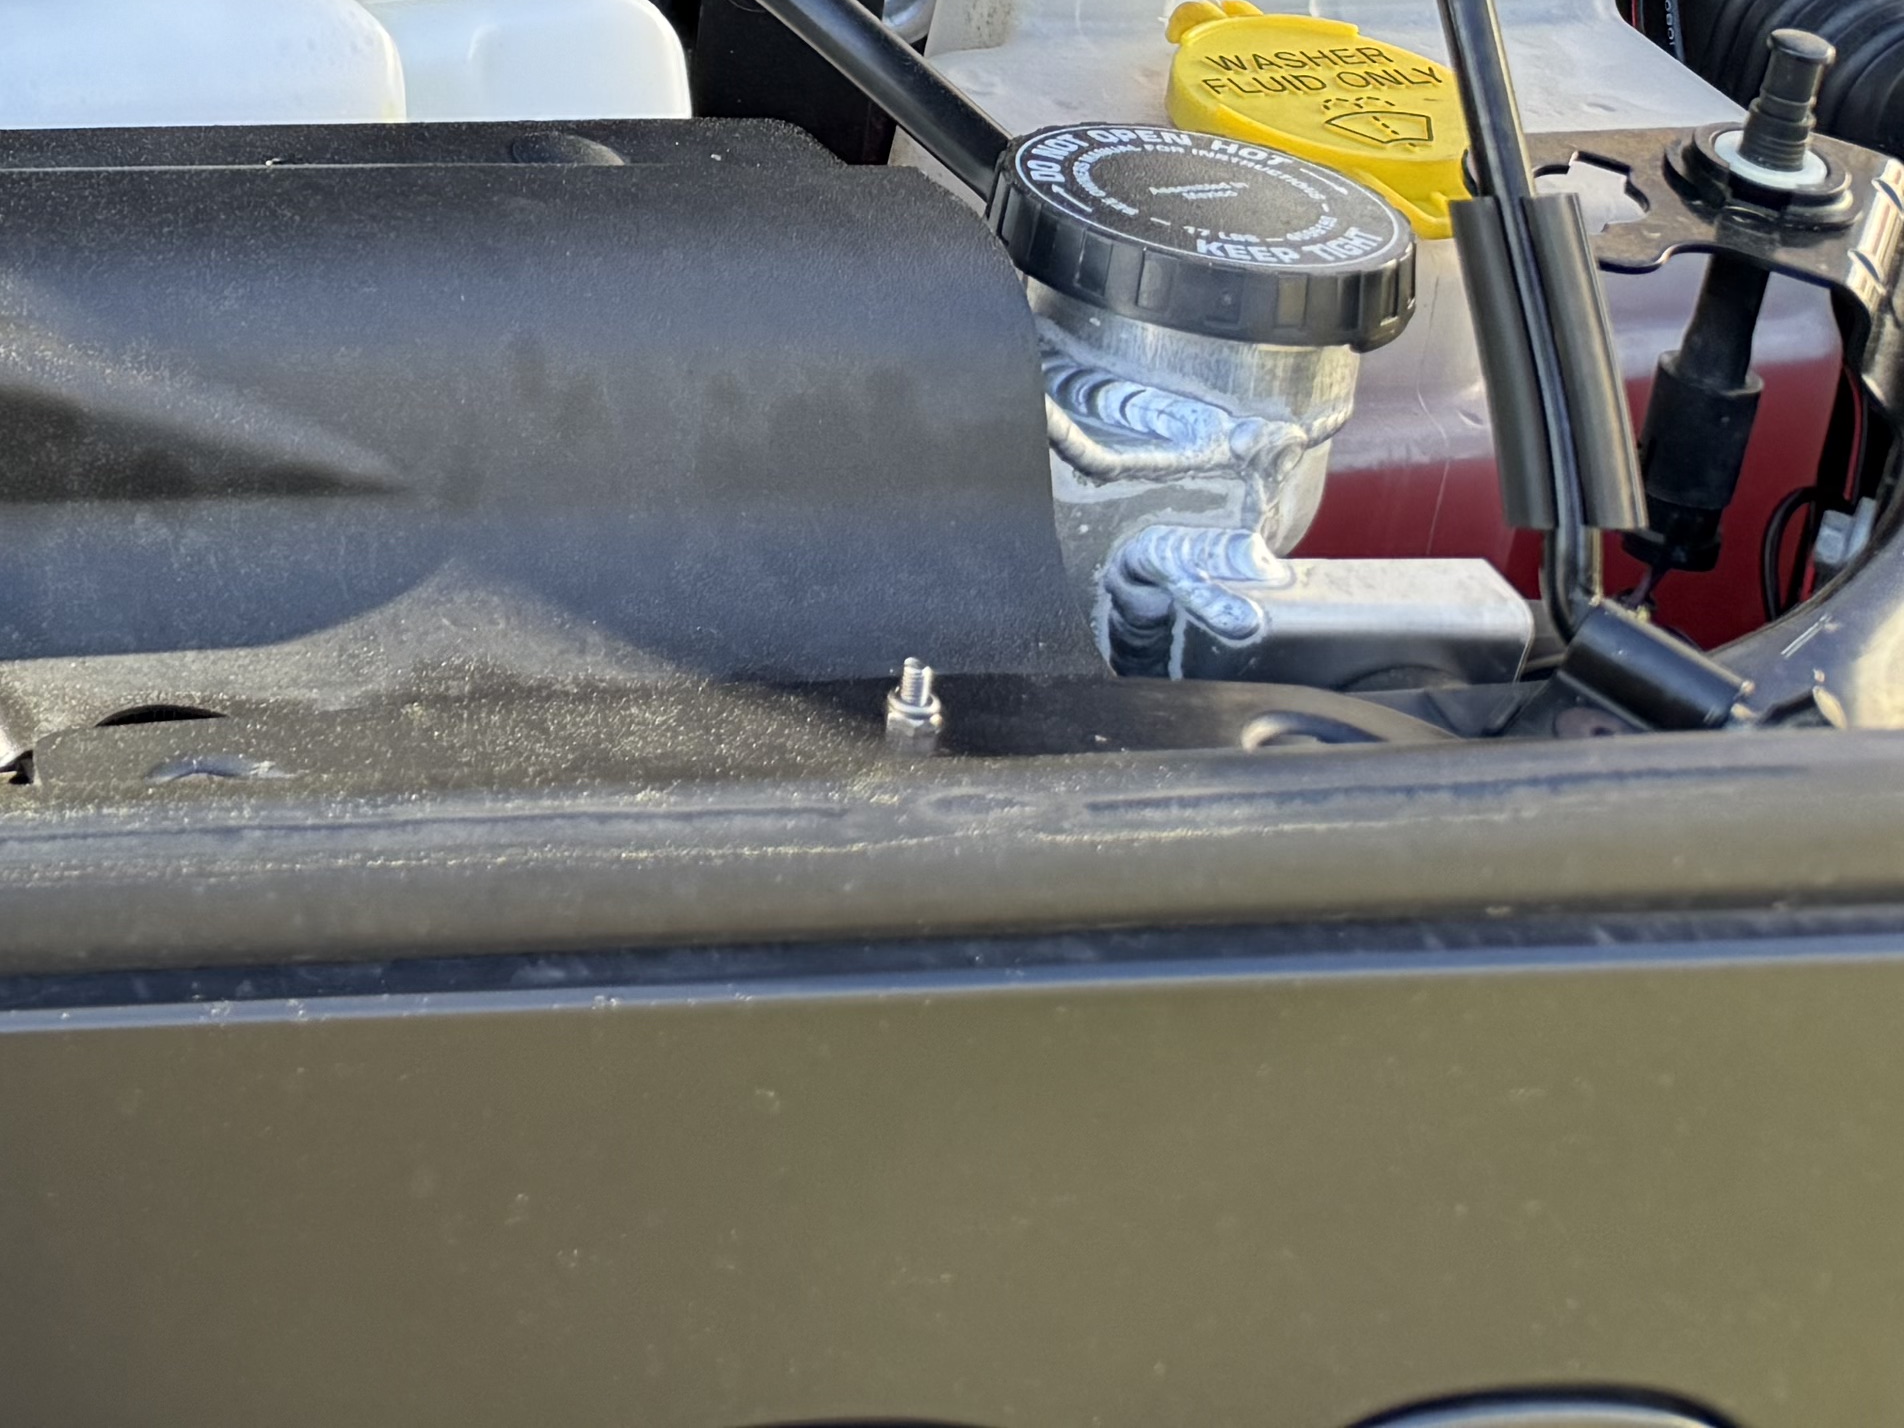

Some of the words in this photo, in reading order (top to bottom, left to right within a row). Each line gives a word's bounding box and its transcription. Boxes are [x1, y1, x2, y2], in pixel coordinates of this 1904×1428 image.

[1205, 46, 1395, 72] WASHER
[1201, 73, 1328, 96] FLUID
[1335, 66, 1443, 90] ONLY
[1030, 133, 1090, 161] NOT
[1086, 128, 1193, 145] OPEN
[1142, 144, 1185, 154] FOR
[1210, 139, 1295, 166] HOT
[1026, 159, 1066, 183] DO
[1195, 238, 1301, 264] KEEP
[1301, 225, 1384, 262] TIGHT
